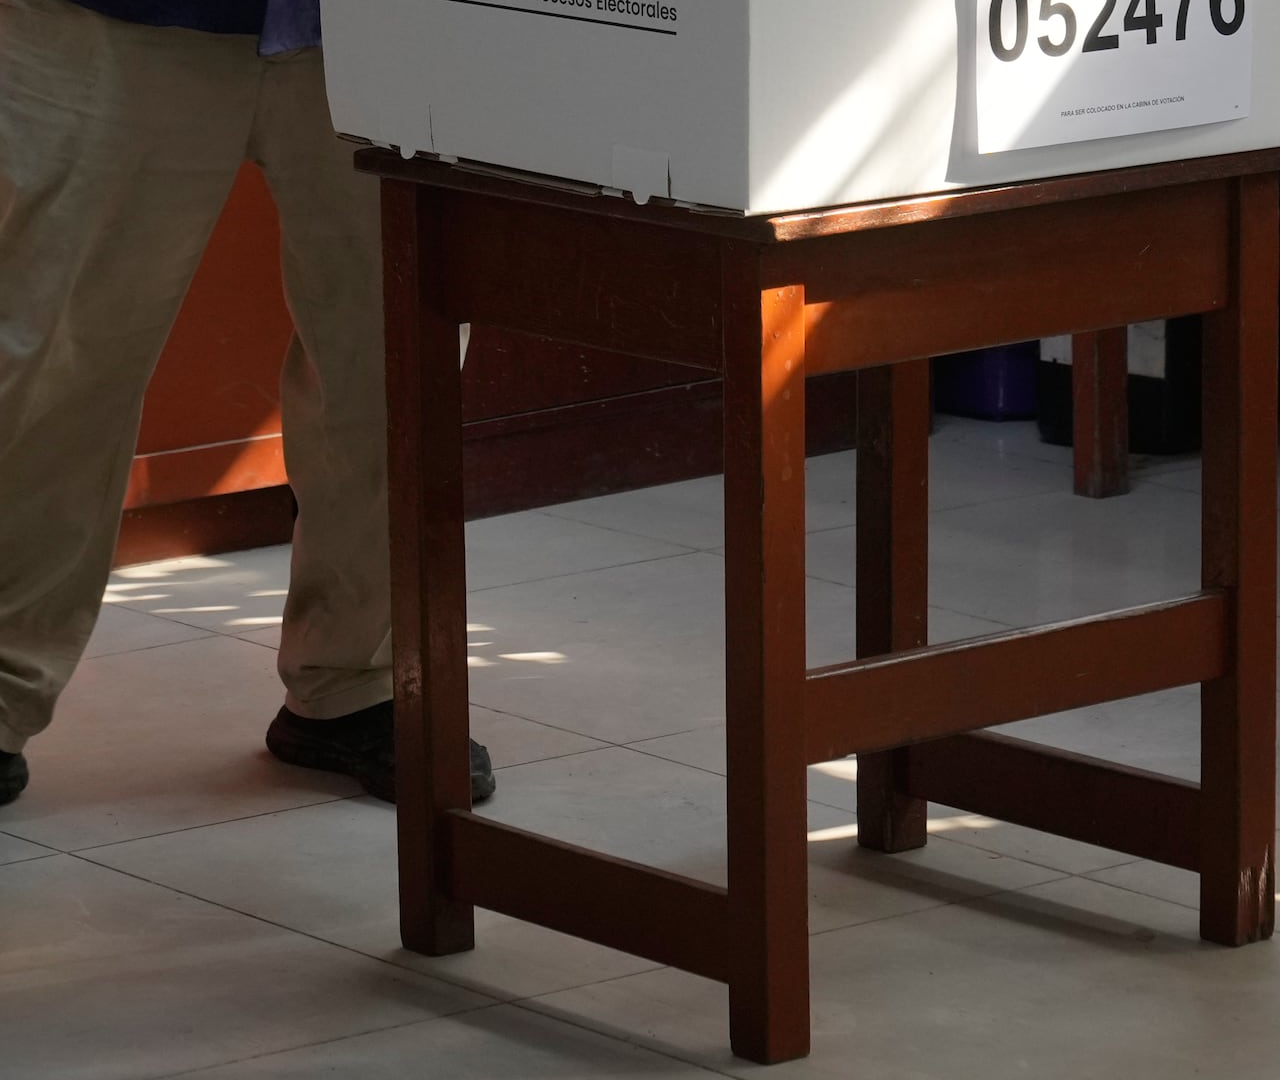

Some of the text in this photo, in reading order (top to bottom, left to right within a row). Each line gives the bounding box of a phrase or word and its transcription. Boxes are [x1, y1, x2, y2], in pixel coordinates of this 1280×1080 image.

[1060, 109, 1074, 117] PARA
[1075, 108, 1085, 116] SER
[1086, 104, 1116, 114] COLOCADO
[1132, 100, 1151, 109] CABINA
[1151, 98, 1159, 106] DE
